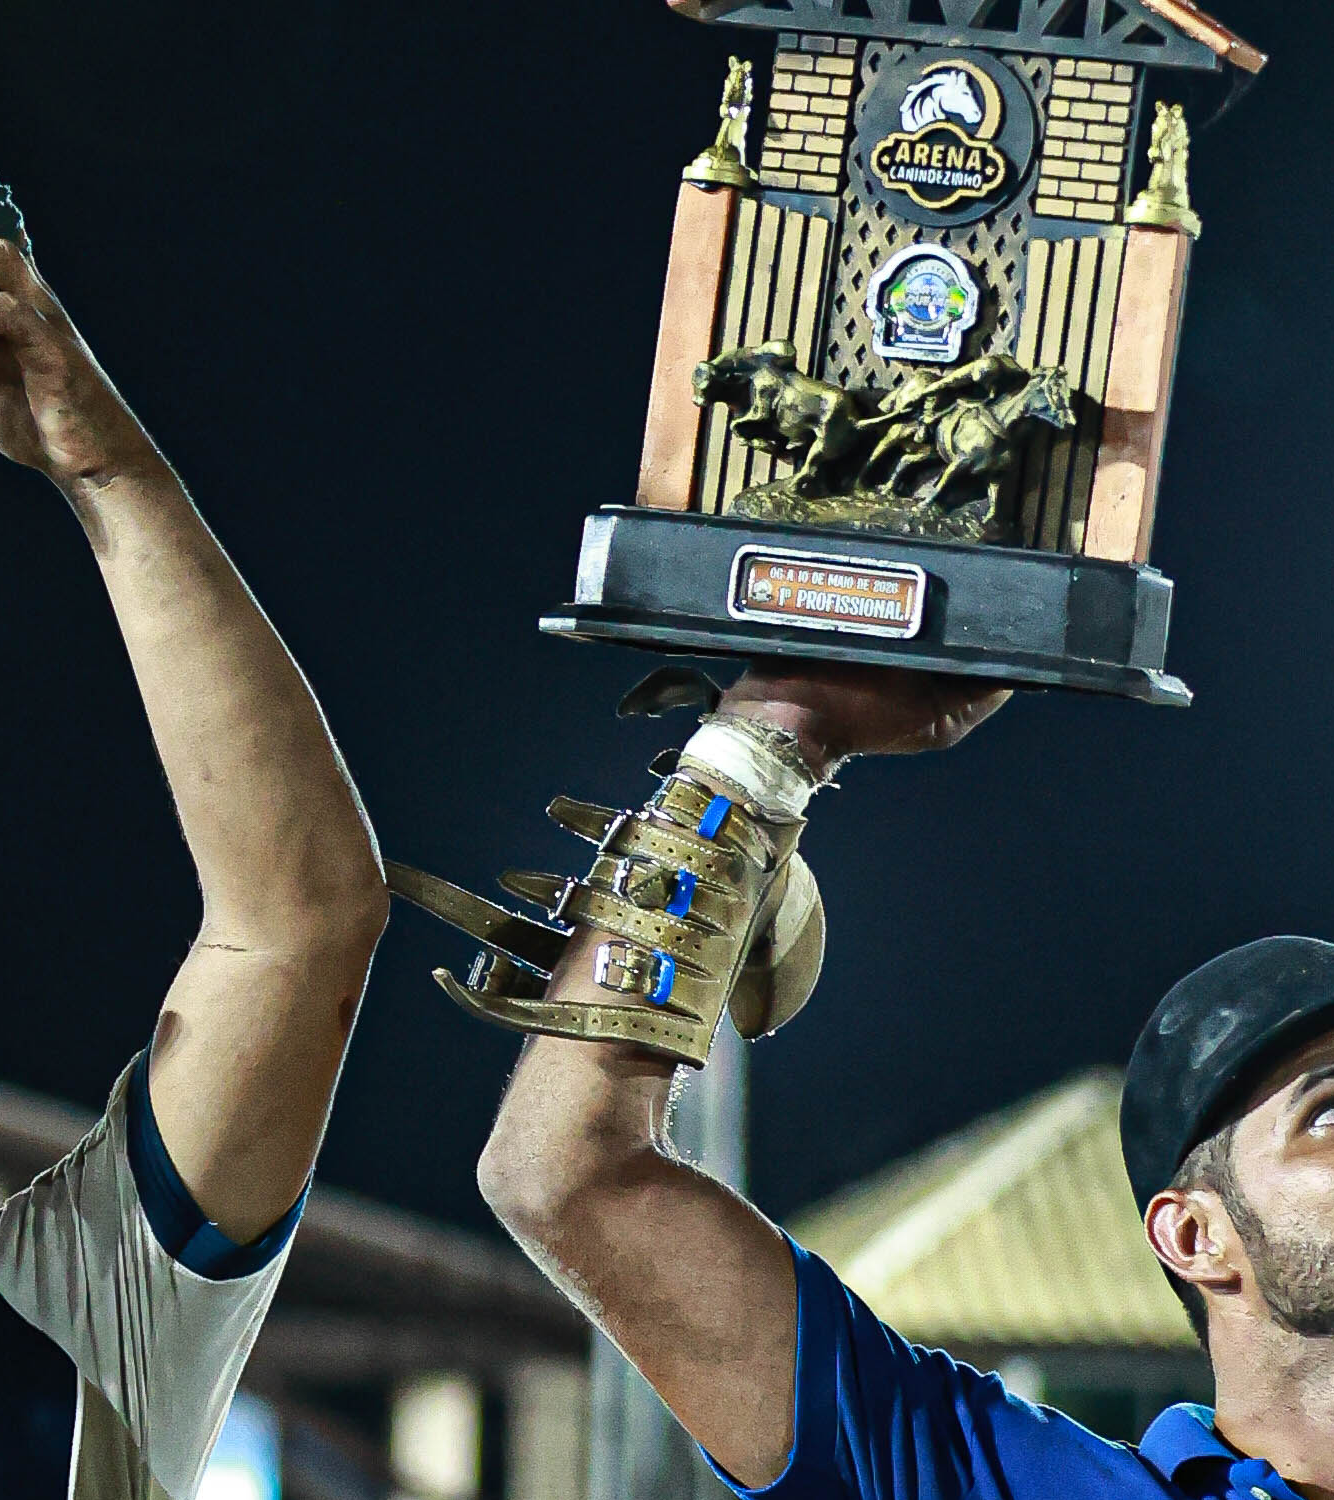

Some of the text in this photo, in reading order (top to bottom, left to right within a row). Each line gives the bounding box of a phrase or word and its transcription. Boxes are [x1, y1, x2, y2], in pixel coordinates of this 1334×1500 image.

[894, 141, 983, 171] ARENA
[889, 166, 983, 189] CANINDEZINHO
[786, 567, 794, 582] A
[798, 569, 809, 583] 10
[811, 571, 825, 586] DE
[827, 573, 854, 589] MAIO
[856, 577, 870, 592] DE
[796, 589, 904, 621] PROFISSIONAL
